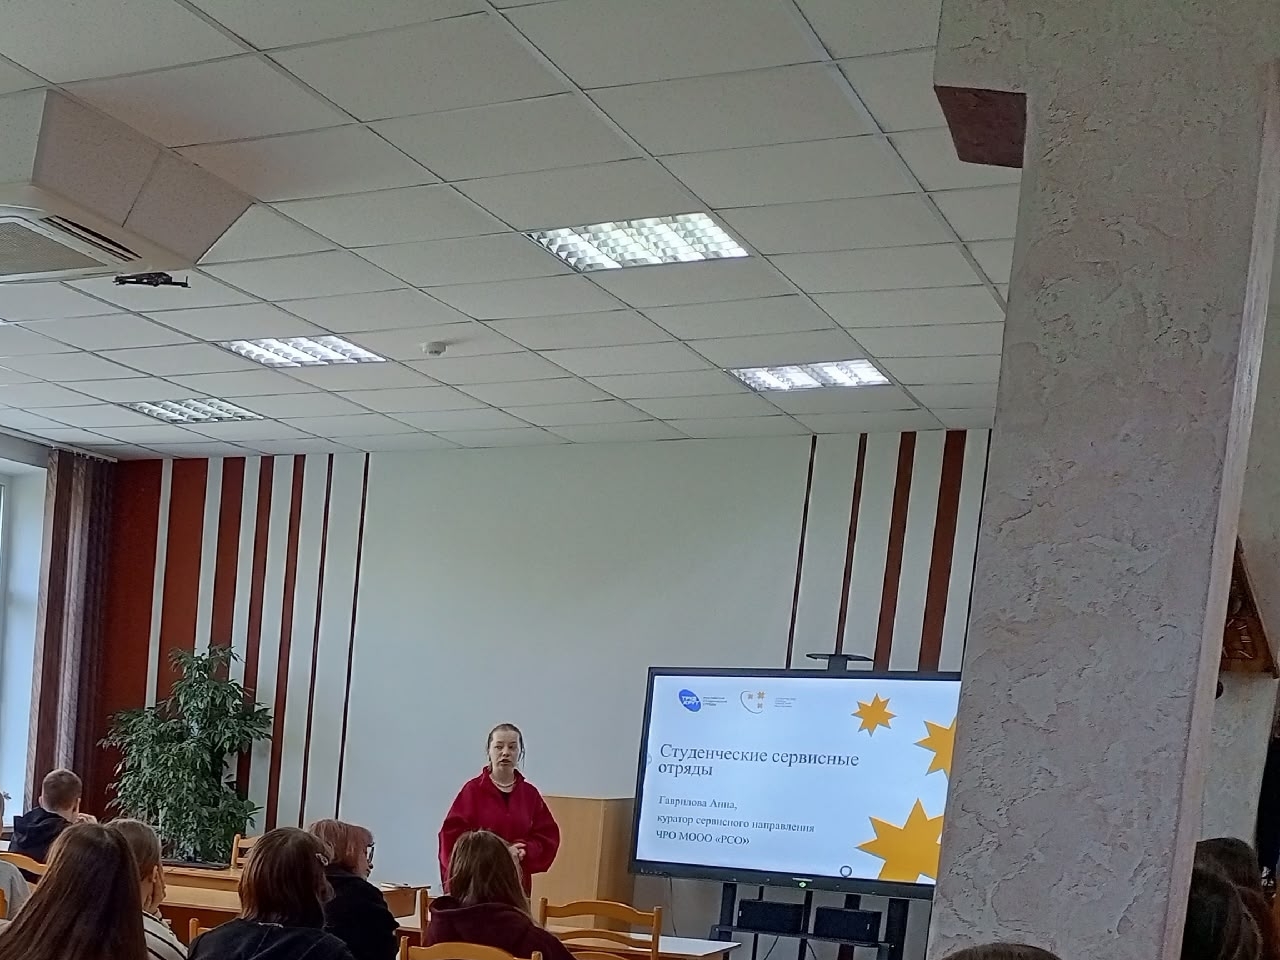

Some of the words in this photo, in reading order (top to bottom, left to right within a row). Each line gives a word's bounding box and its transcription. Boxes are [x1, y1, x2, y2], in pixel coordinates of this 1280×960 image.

[660, 743, 768, 762] Студенческие
[772, 751, 859, 767] сервисные
[658, 763, 713, 777] отряды
[658, 796, 707, 807] Гаврилова
[709, 799, 738, 811] Анна,
[657, 815, 694, 826] куратор
[696, 818, 749, 828] сервисного
[752, 821, 815, 832] направления
[656, 830, 677, 840] ЧРО
[678, 832, 713, 843] МООО
[715, 836, 750, 845] «РСО»
